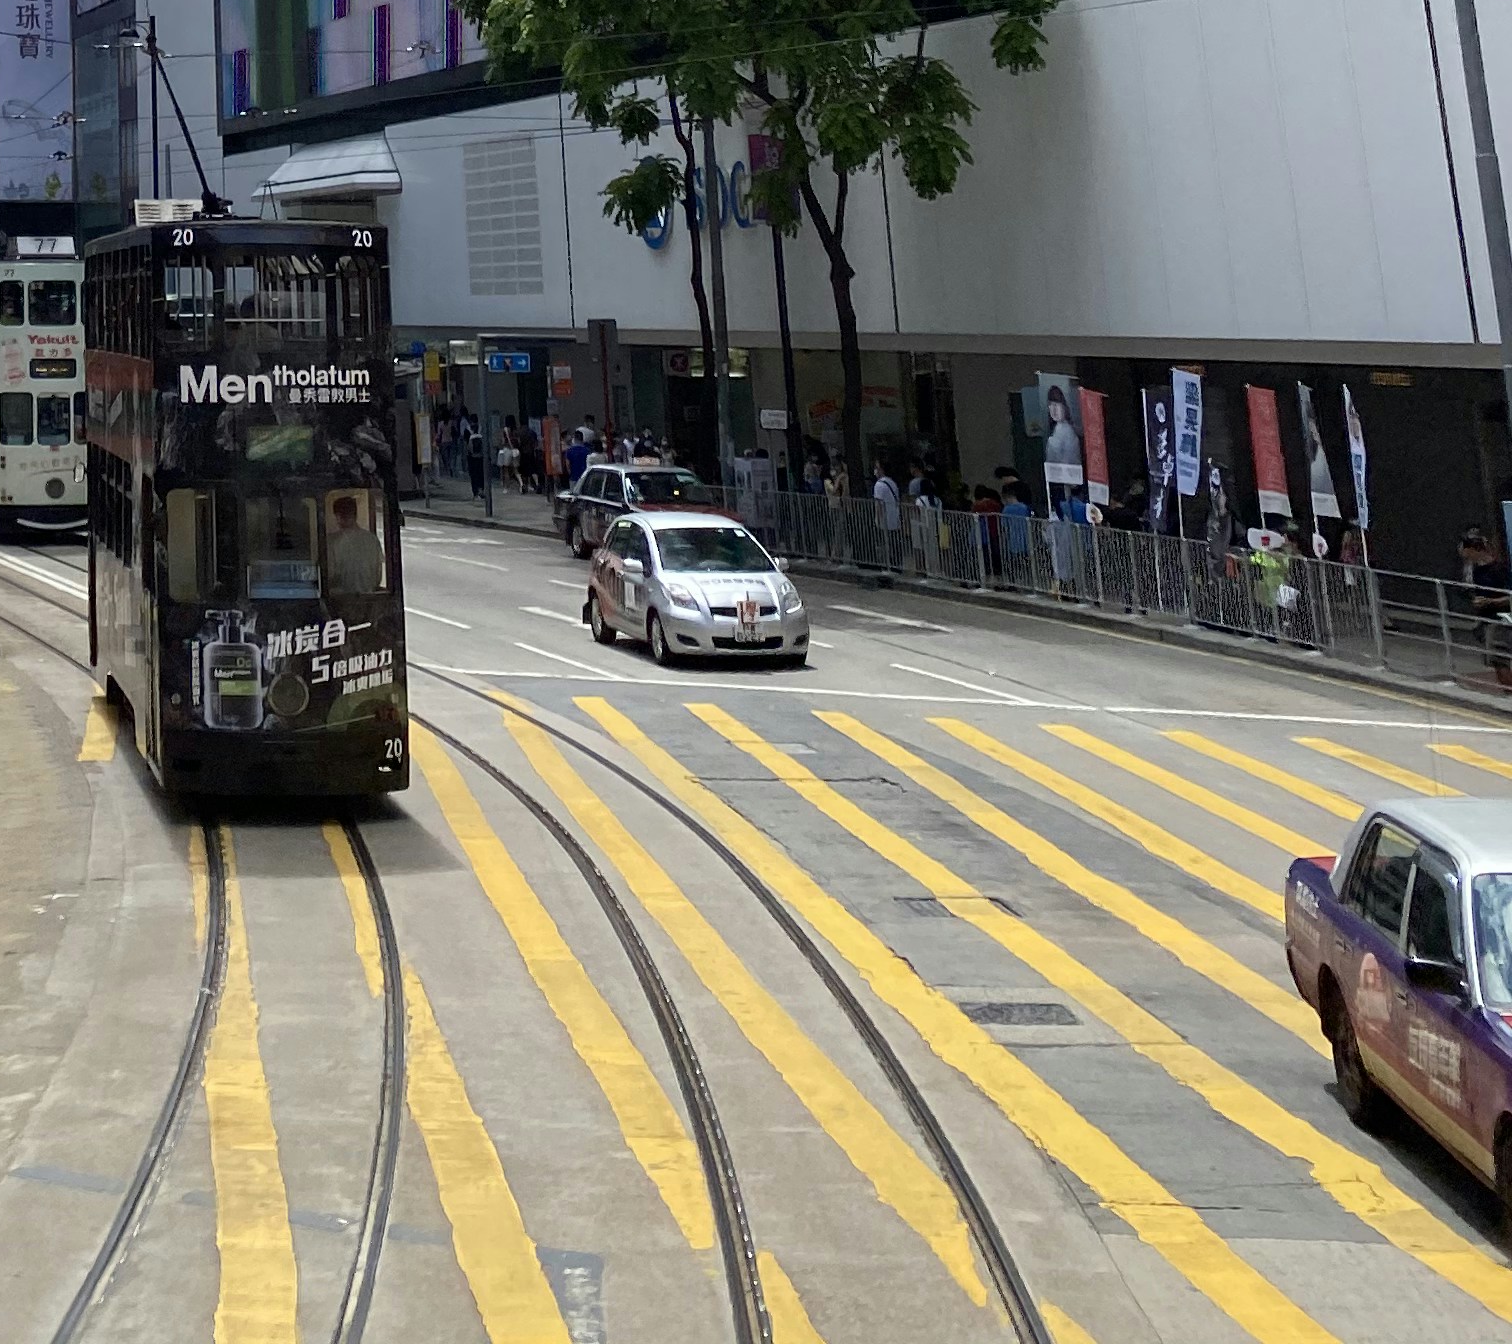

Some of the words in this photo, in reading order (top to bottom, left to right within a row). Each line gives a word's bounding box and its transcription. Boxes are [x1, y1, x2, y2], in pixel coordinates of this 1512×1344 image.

[34, 238, 58, 253] 77
[172, 228, 194, 247] 20
[352, 229, 373, 248] 20
[27, 335, 80, 345] Yakult
[179, 364, 370, 404] Mentholatum
[288, 387, 371, 404] 曼秀雷敦男士
[267, 618, 372, 660] 冰炭合一
[384, 737, 403, 759] 20
